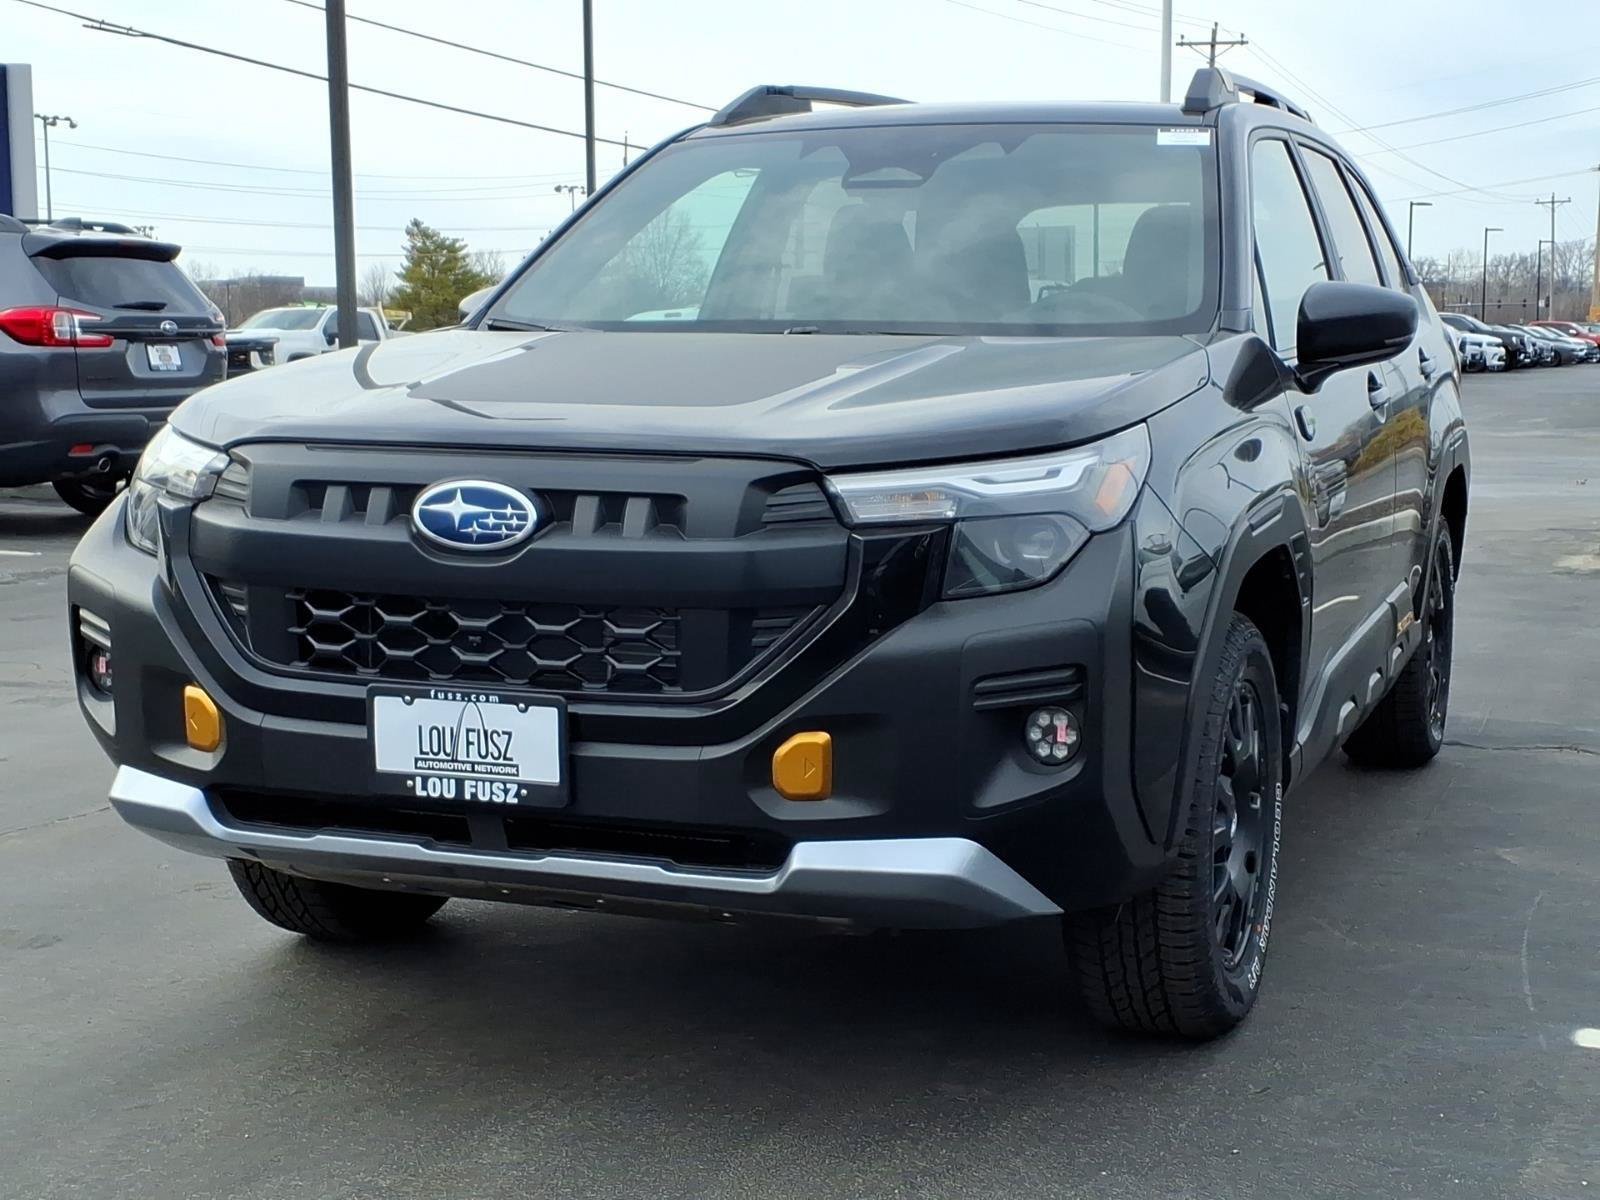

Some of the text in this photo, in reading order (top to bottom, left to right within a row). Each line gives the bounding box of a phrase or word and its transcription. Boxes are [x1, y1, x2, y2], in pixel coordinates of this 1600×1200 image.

[430, 689, 499, 703] fusz.com
[419, 724, 513, 762] LOU FUSZ
[417, 760, 517, 775] AUTOMOTIVE NETWORK
[415, 776, 519, 804] LOU FUSZ
[1259, 782, 1282, 953] GEOLANDAR
